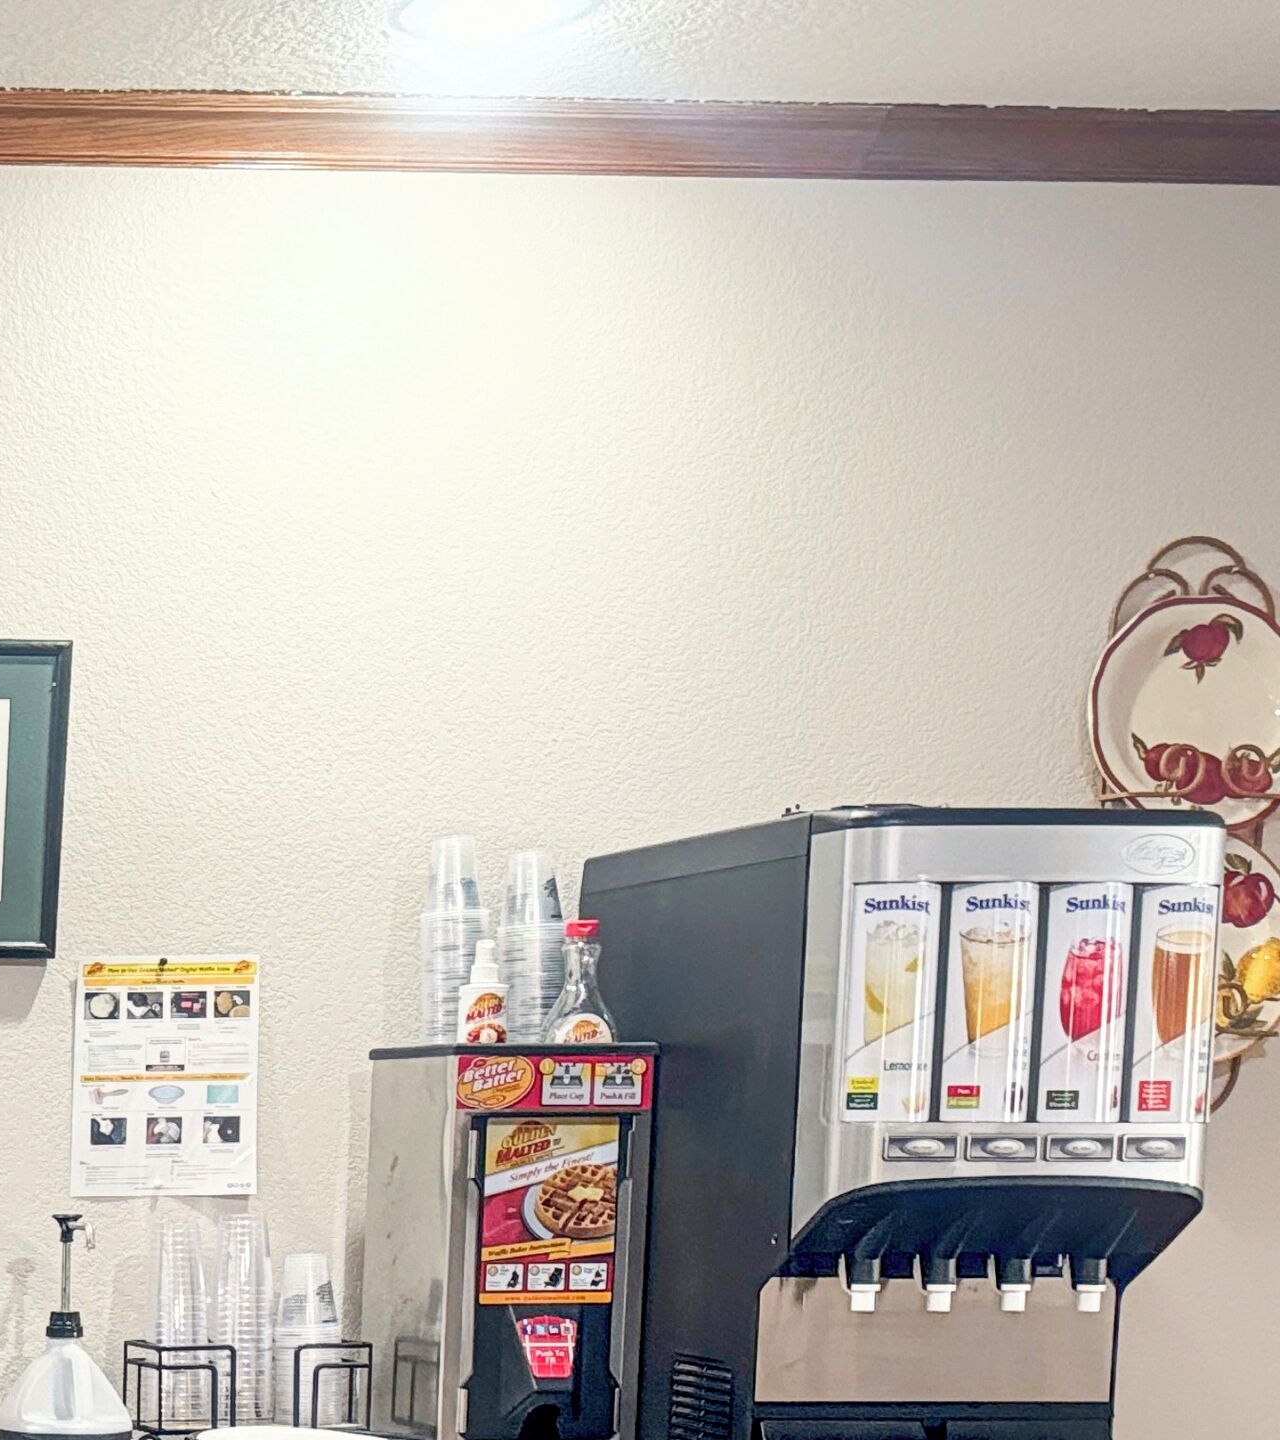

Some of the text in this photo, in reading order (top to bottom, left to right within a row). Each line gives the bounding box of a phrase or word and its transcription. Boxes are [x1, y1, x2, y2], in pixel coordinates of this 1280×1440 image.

[864, 894, 931, 915] Sunkist
[965, 893, 1031, 914] Sunkist
[463, 1058, 517, 1083] Better
[884, 1060, 927, 1072] Lemoe
[471, 1068, 526, 1093] Batter
[496, 1139, 551, 1164] MALTED
[508, 1167, 543, 1183] Simply
[544, 1162, 559, 1173] the
[535, 1349, 554, 1357] Push
